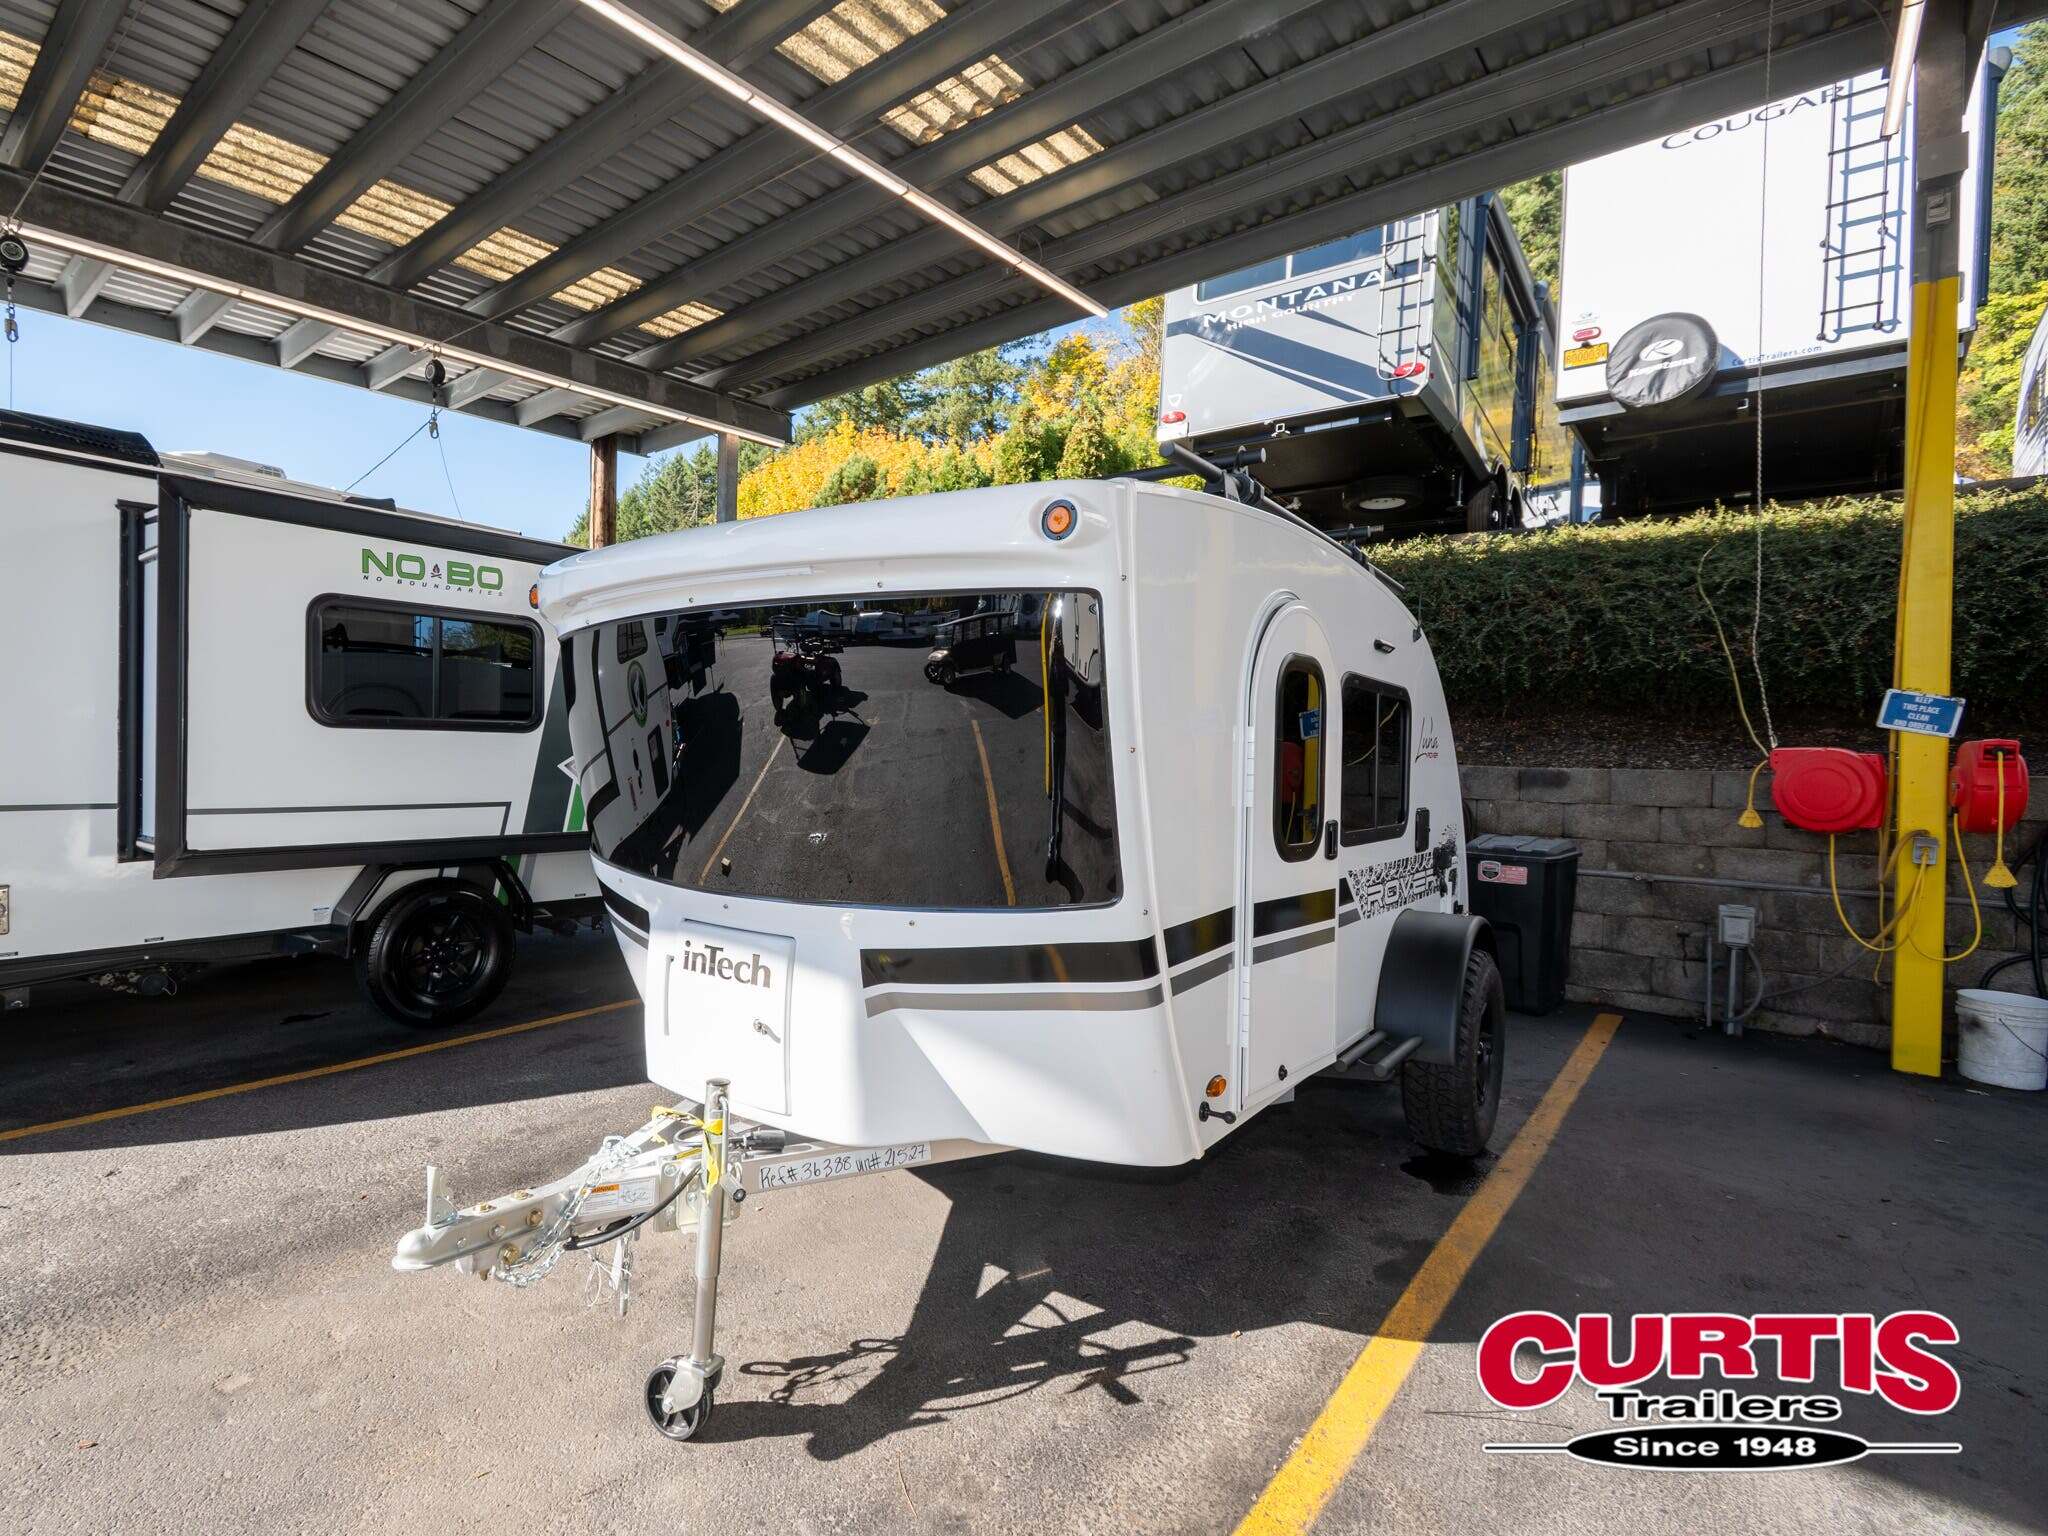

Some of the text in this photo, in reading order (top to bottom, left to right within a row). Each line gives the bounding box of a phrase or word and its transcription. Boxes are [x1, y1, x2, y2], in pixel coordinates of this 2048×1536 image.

[1662, 86, 1845, 149] COUGAR
[1203, 269, 1385, 328] MONTANA
[397, 580, 503, 596] BOUNDARIES
[1915, 696, 1934, 704] KEEP
[1903, 703, 1941, 714] THIS PLACE
[1908, 712, 1930, 721] CLEAN
[1893, 719, 1939, 731] AND ORDERLY
[683, 940, 771, 988] inTech
[761, 1166, 798, 1188] Ref#
[802, 1156, 852, 1180] 36388
[885, 1144, 927, 1167] 21527
